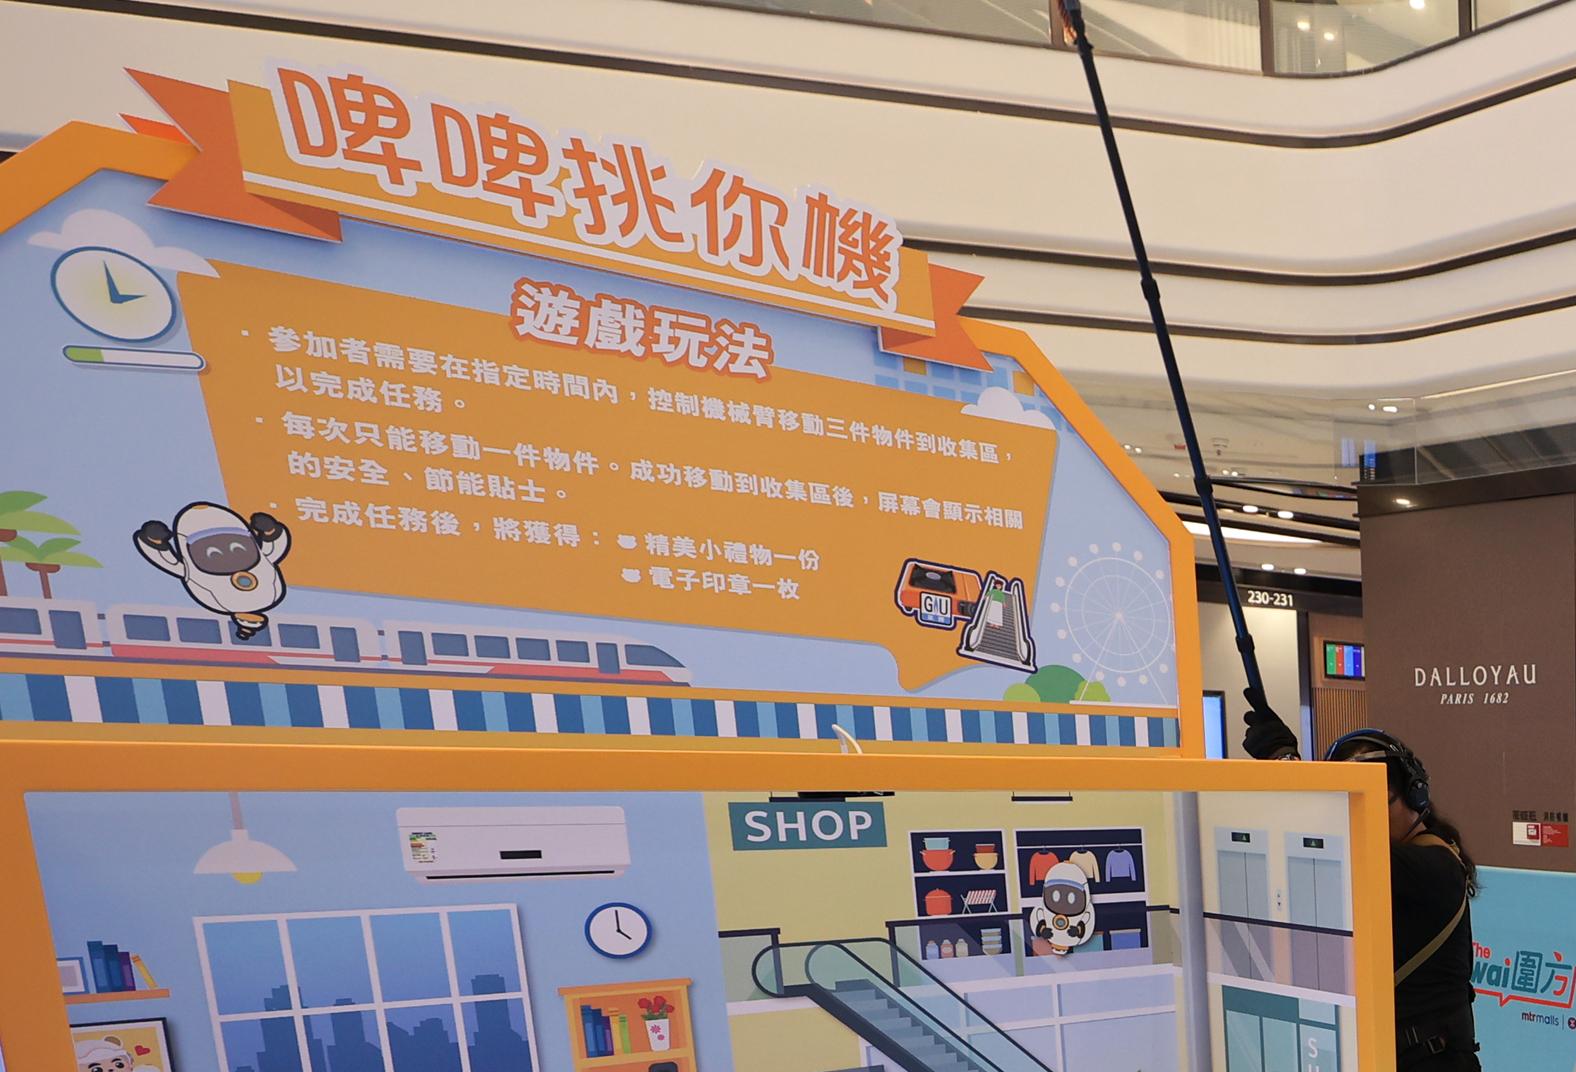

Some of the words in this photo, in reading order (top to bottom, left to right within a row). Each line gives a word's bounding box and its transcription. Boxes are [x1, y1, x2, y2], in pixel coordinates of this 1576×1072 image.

[277, 66, 894, 305] 啤啤挑你機
[516, 282, 771, 375] 遊戲玩法
[275, 363, 465, 414] 以完成任務。
[287, 450, 567, 503] 的安全、節能貼士。
[644, 532, 821, 572] 精美小禮物一份
[648, 565, 800, 600] 電子印章一枚
[1247, 590, 1294, 608] 230-231
[1414, 664, 1536, 687] DALLOYAU
[1440, 693, 1474, 705] PARIS
[1483, 692, 1510, 704] 1682
[744, 810, 873, 842] SHOP
[1521, 1011, 1560, 1027] mtrmalls
